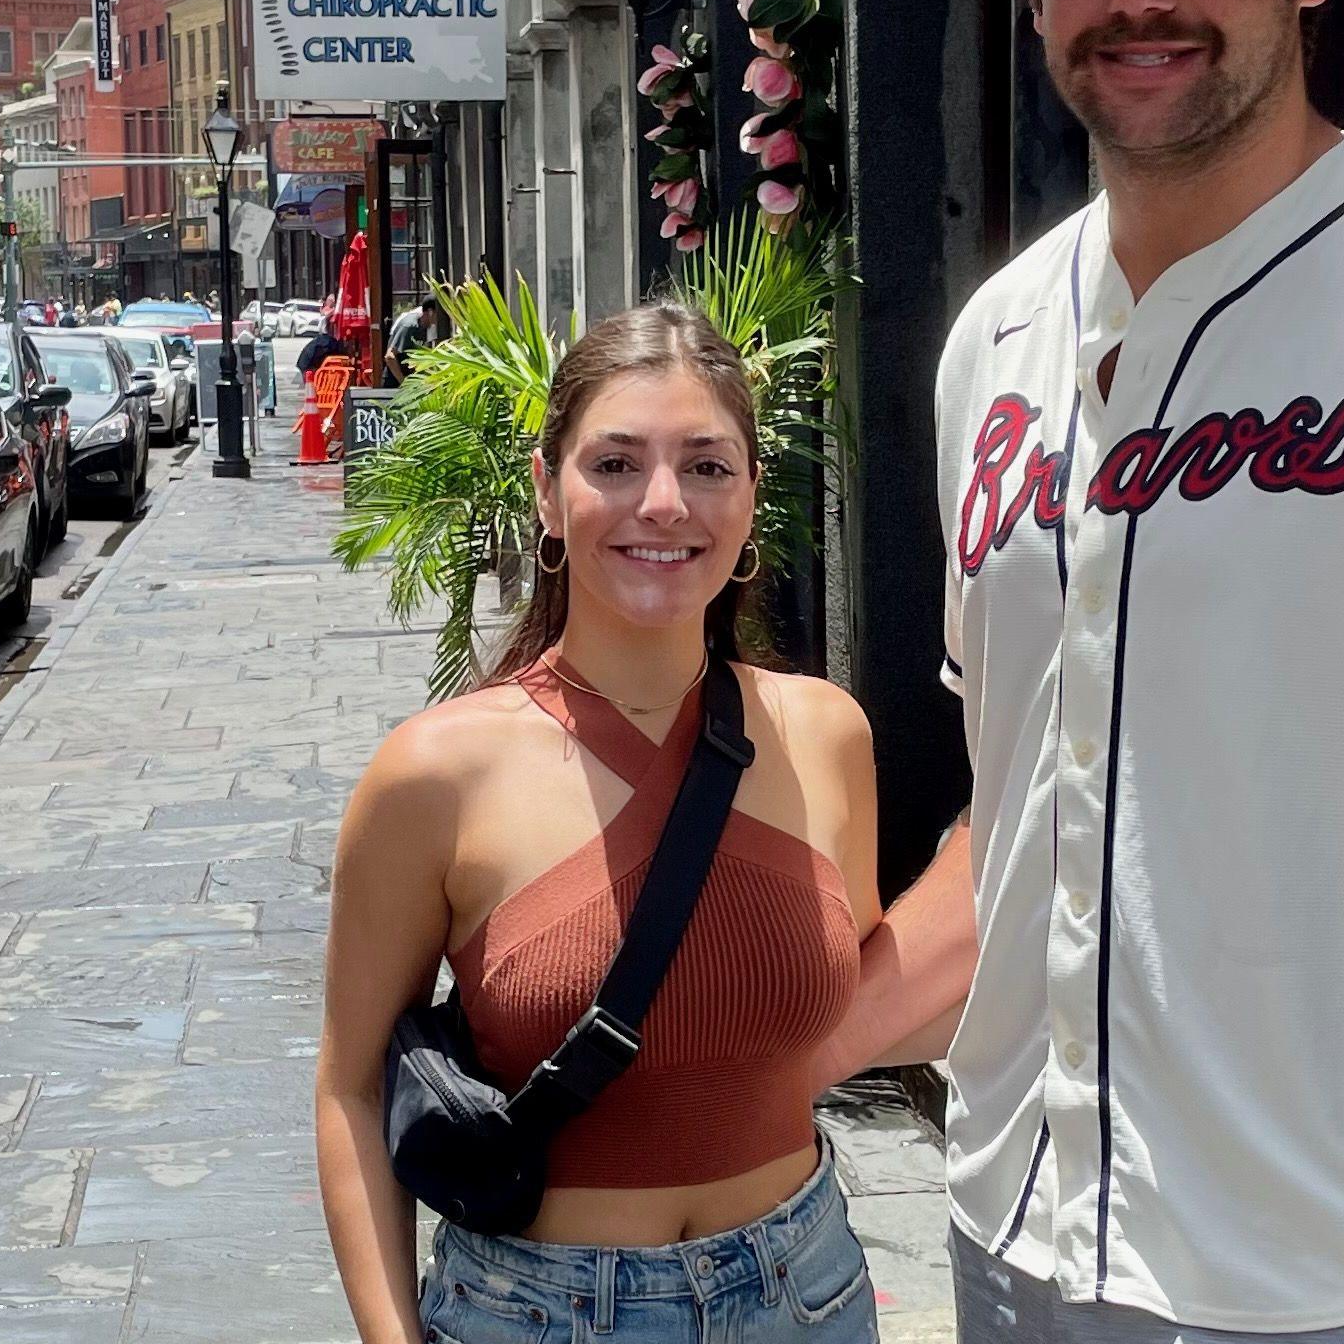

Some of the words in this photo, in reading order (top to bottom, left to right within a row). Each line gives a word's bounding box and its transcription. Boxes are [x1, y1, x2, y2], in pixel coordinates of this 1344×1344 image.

[98, 1, 110, 78] MARRIOTT
[303, 36, 415, 64] CENTER
[298, 147, 335, 160] CAFE
